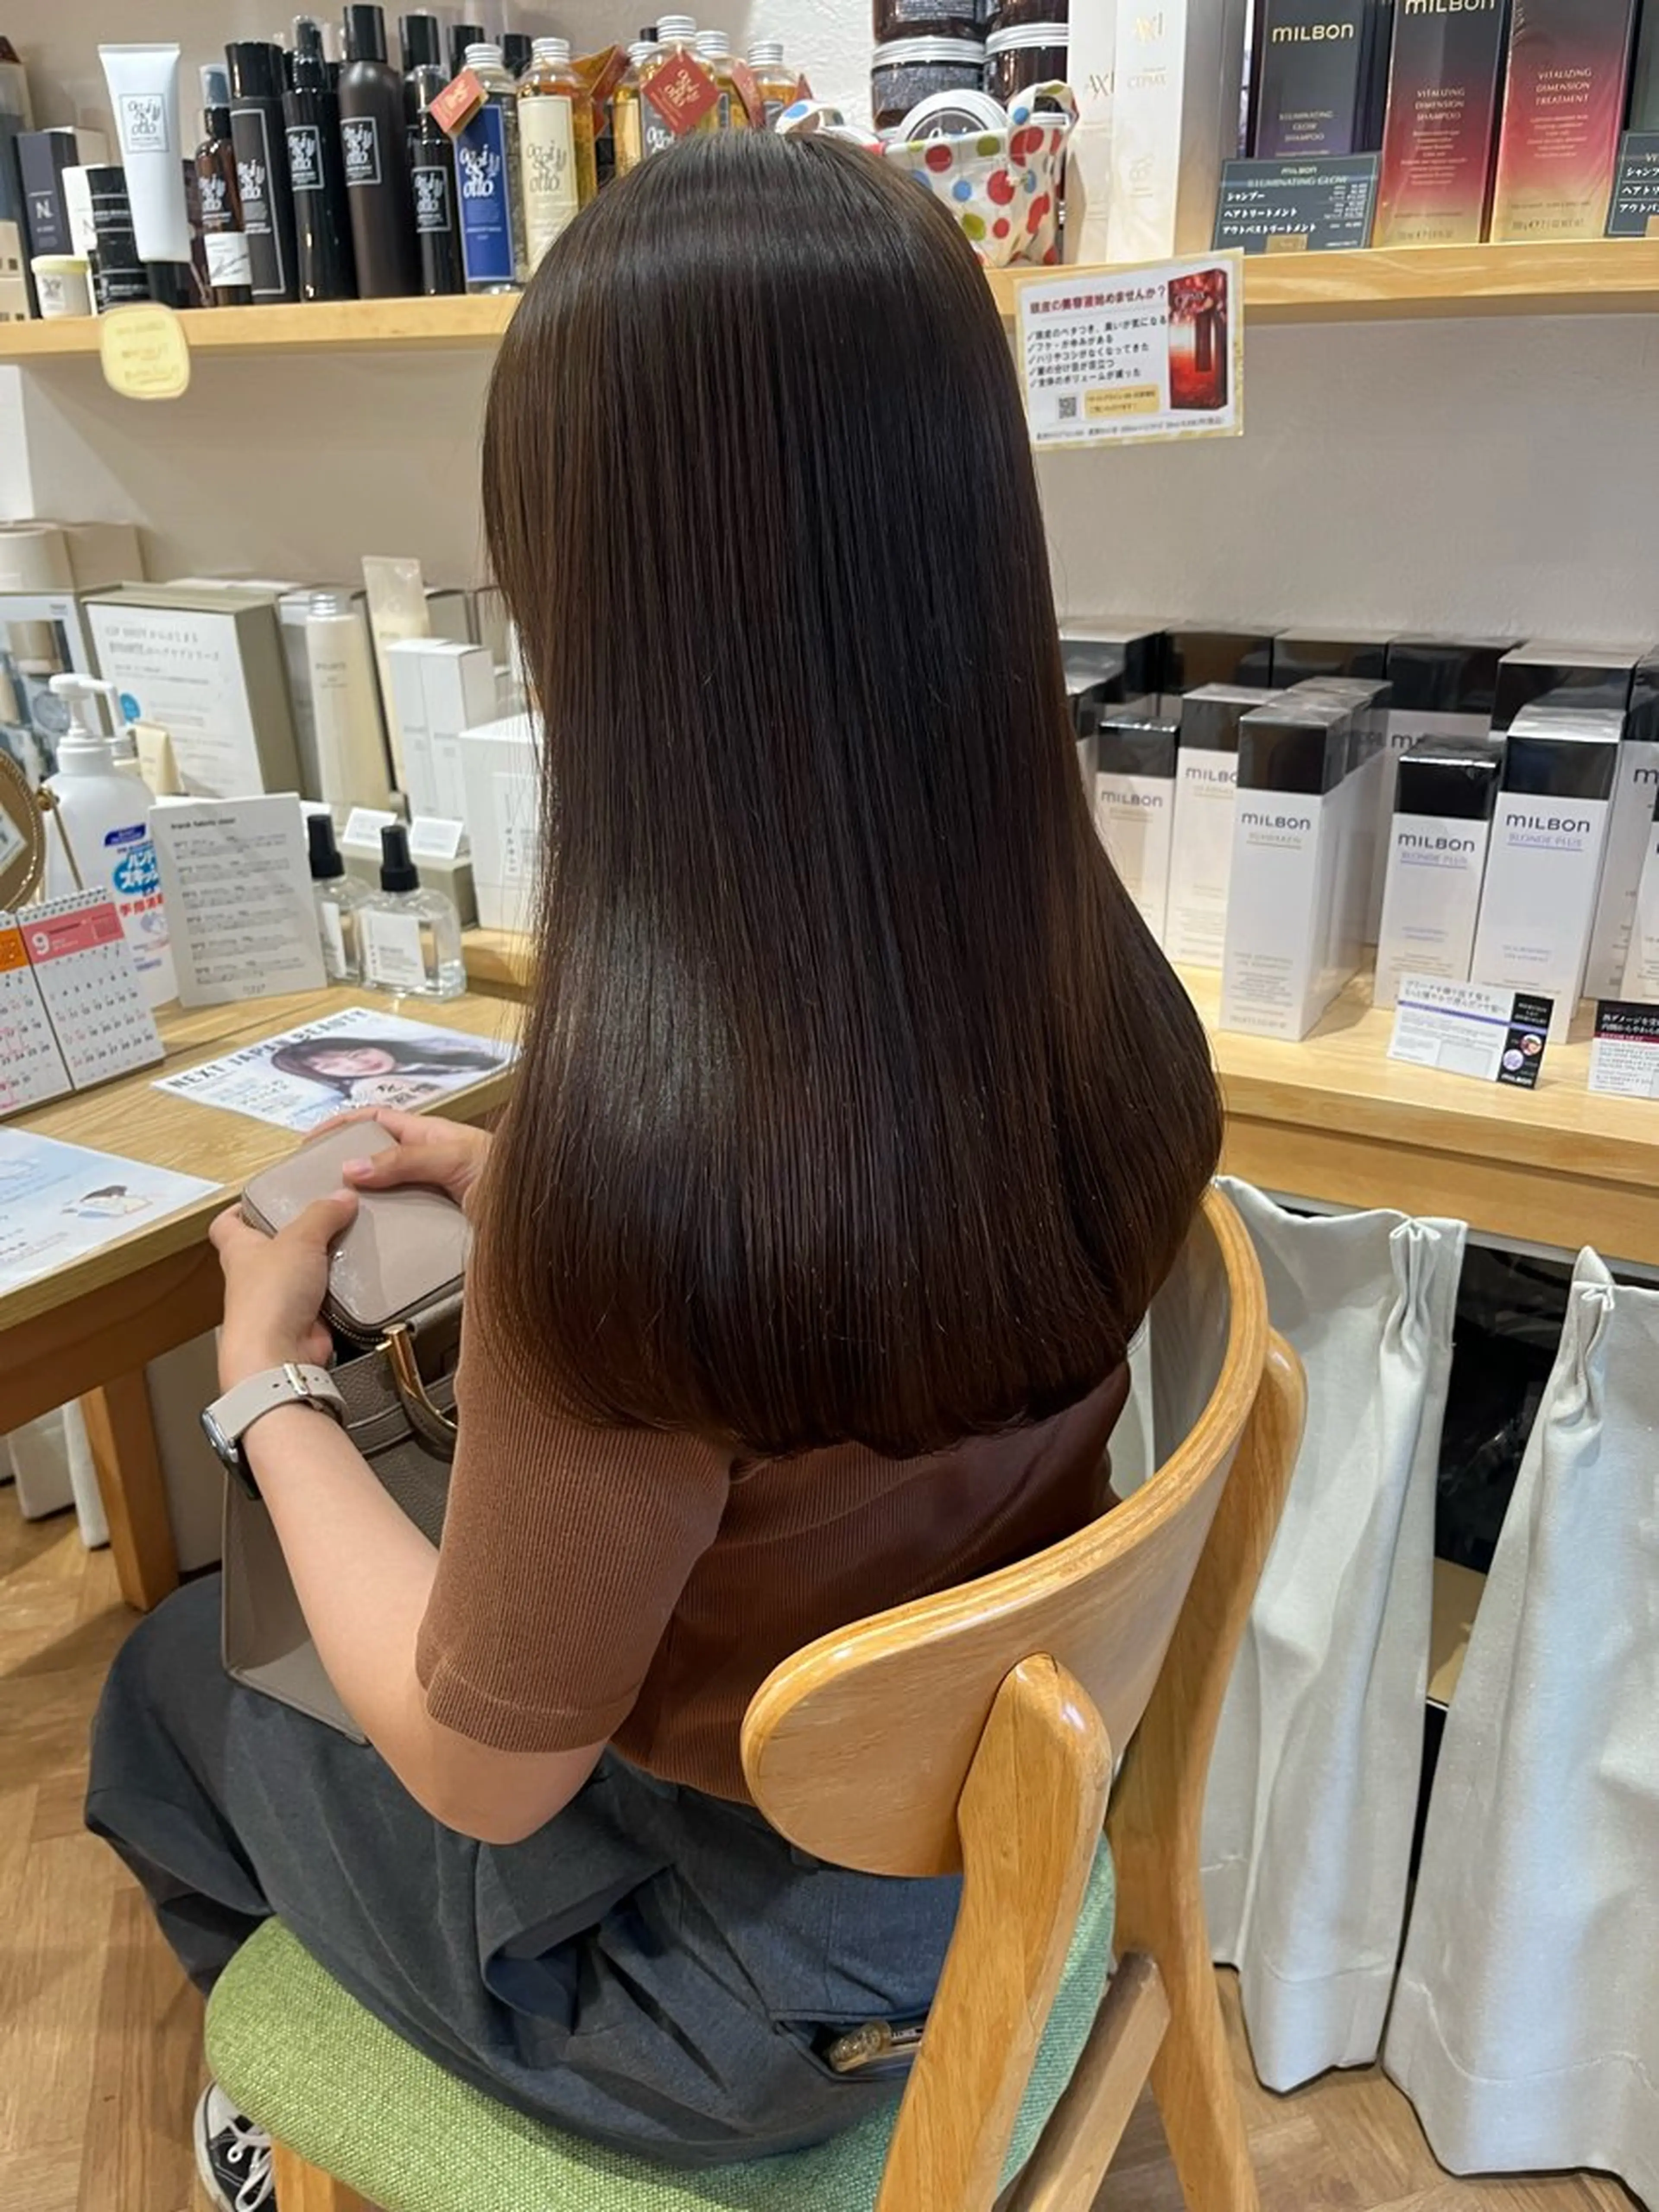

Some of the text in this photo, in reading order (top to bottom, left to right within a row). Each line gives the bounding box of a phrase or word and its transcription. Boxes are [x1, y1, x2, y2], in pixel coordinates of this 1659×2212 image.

[1272, 24, 1354, 42] MILBON
[1227, 191, 1265, 201] シャンプー
[1224, 207, 1297, 219] ヘアトリートメント
[1185, 767, 1237, 783] MILBO
[1101, 790, 1163, 807] MILBON
[1242, 813, 1311, 830] MILBON
[1506, 814, 1590, 833] MILBON
[1398, 833, 1475, 853] MILBON
[32, 933, 50, 956] 9
[167, 1065, 224, 1089] NEXT
